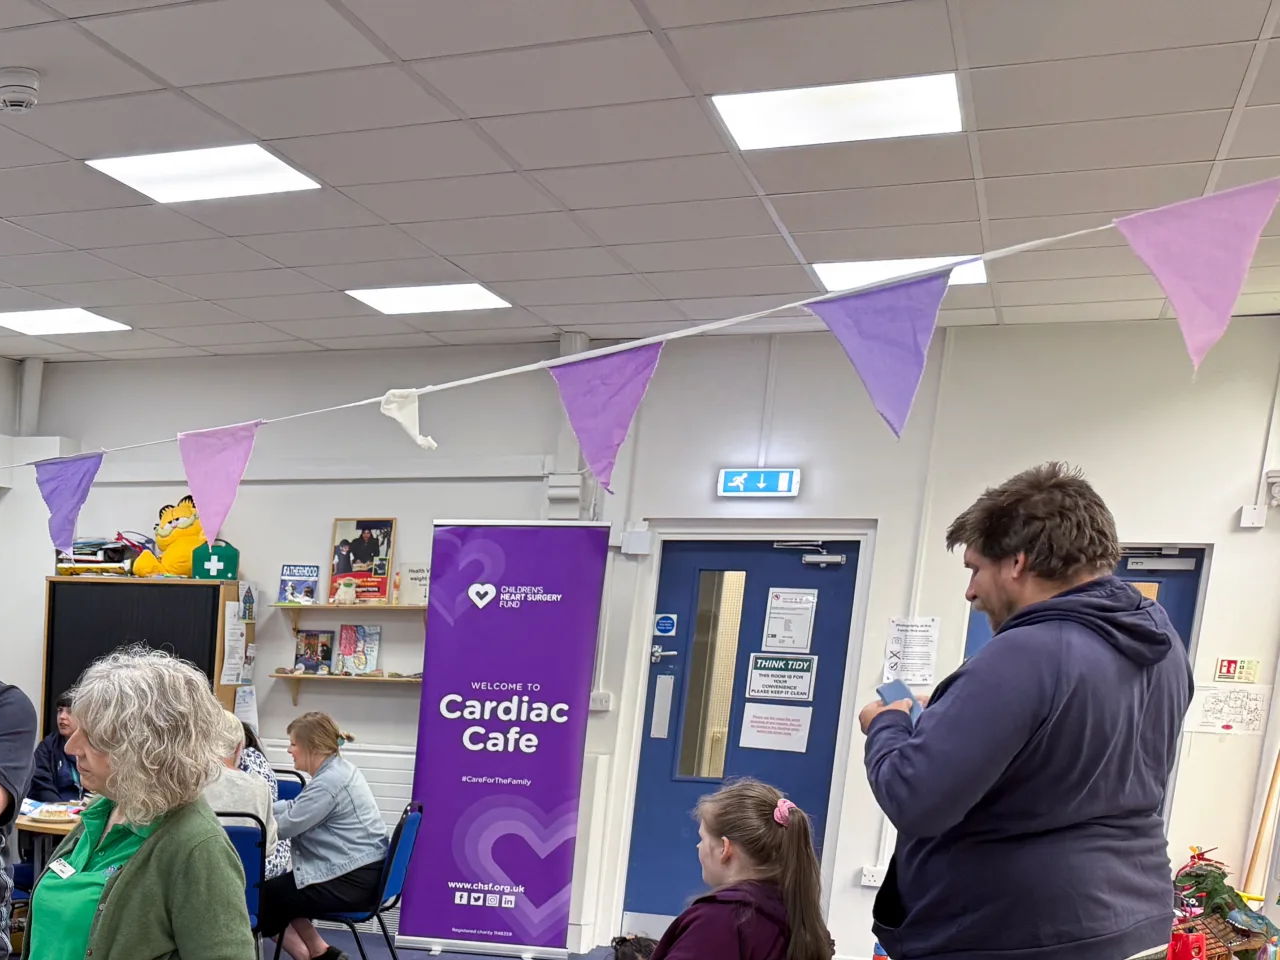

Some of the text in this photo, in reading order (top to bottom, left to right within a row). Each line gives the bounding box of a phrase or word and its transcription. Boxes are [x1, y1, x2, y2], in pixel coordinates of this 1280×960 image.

[283, 566, 317, 576] FATHERHOOD
[527, 594, 562, 602] SURGERY
[756, 659, 810, 670] THINK TIDY
[471, 682, 540, 692] WELCOME TO
[440, 694, 569, 723] Cardiac
[462, 726, 538, 753] Cafe
[461, 776, 531, 786] #CareForTheFamily
[448, 882, 525, 893] www.chsf.org.uk
